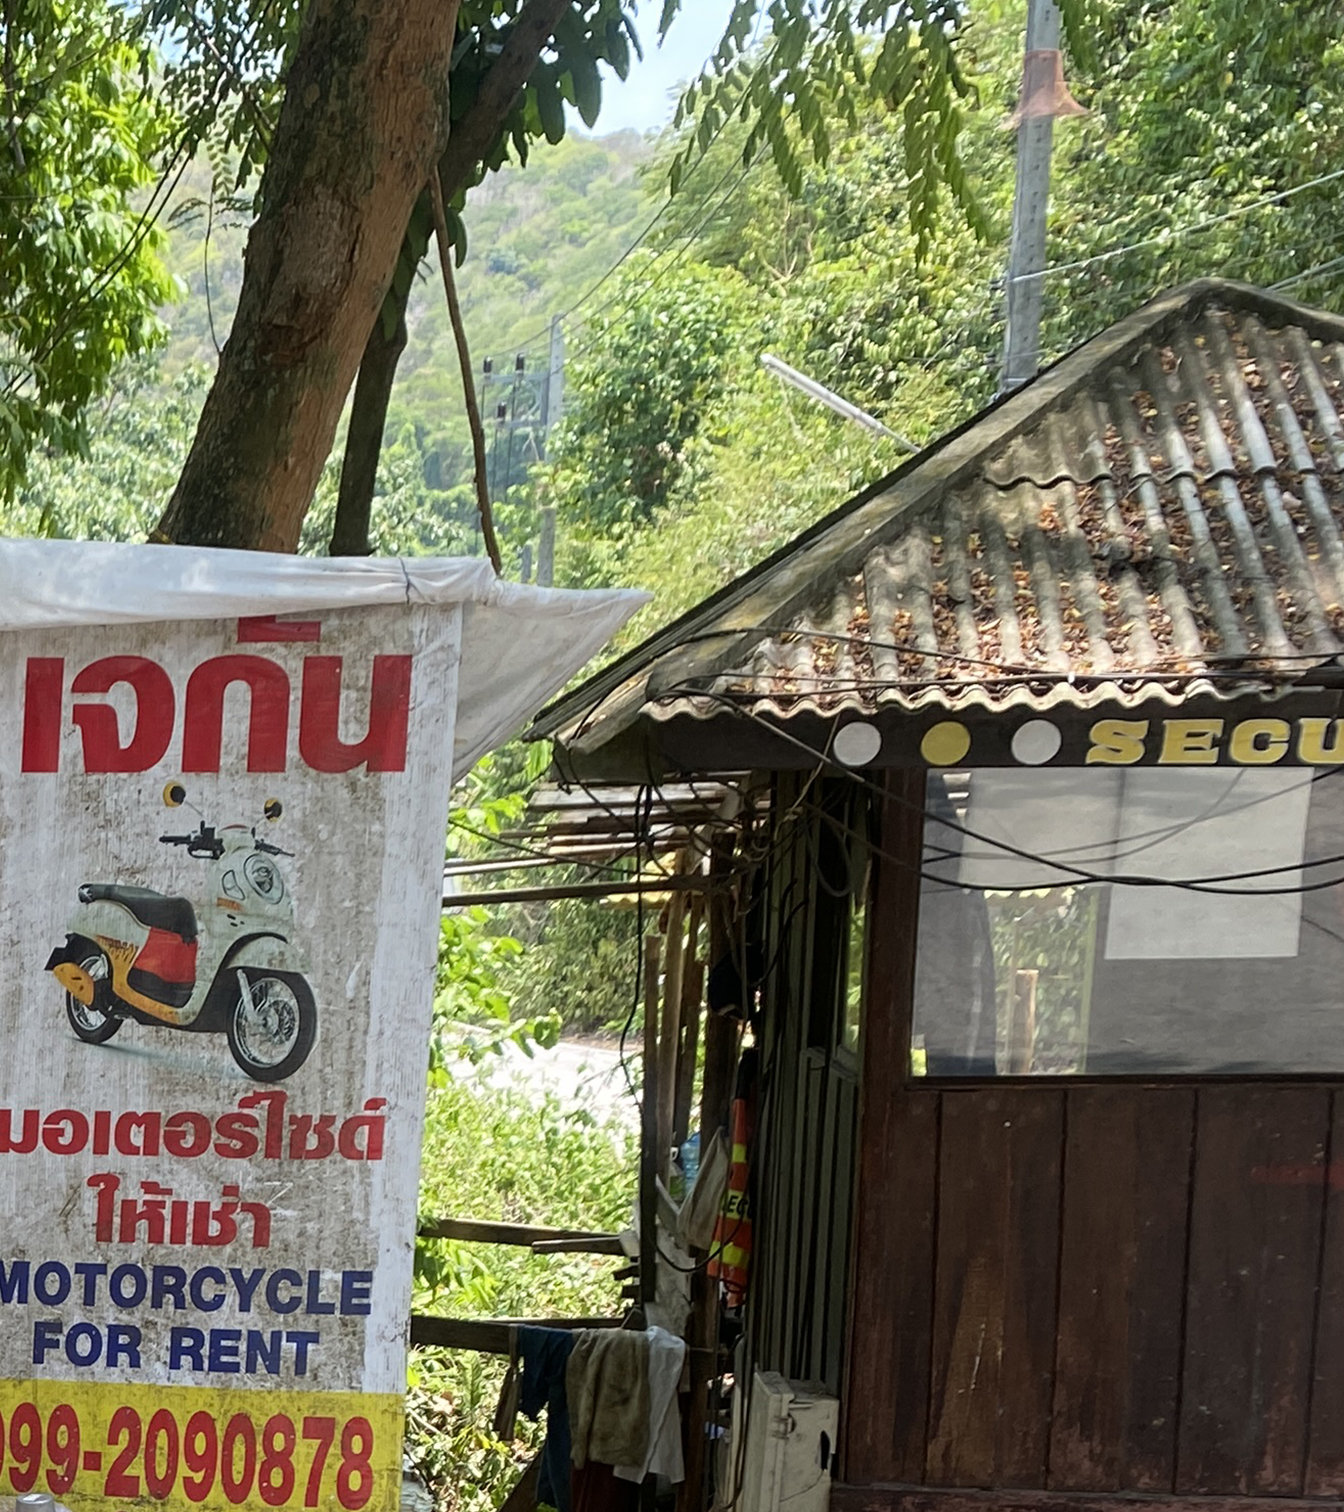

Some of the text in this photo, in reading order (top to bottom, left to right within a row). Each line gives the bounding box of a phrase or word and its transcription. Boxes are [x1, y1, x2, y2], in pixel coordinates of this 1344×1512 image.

[88, 1173, 270, 1247] ให้เช่า
[33, 1322, 320, 1376] FOR RENT
